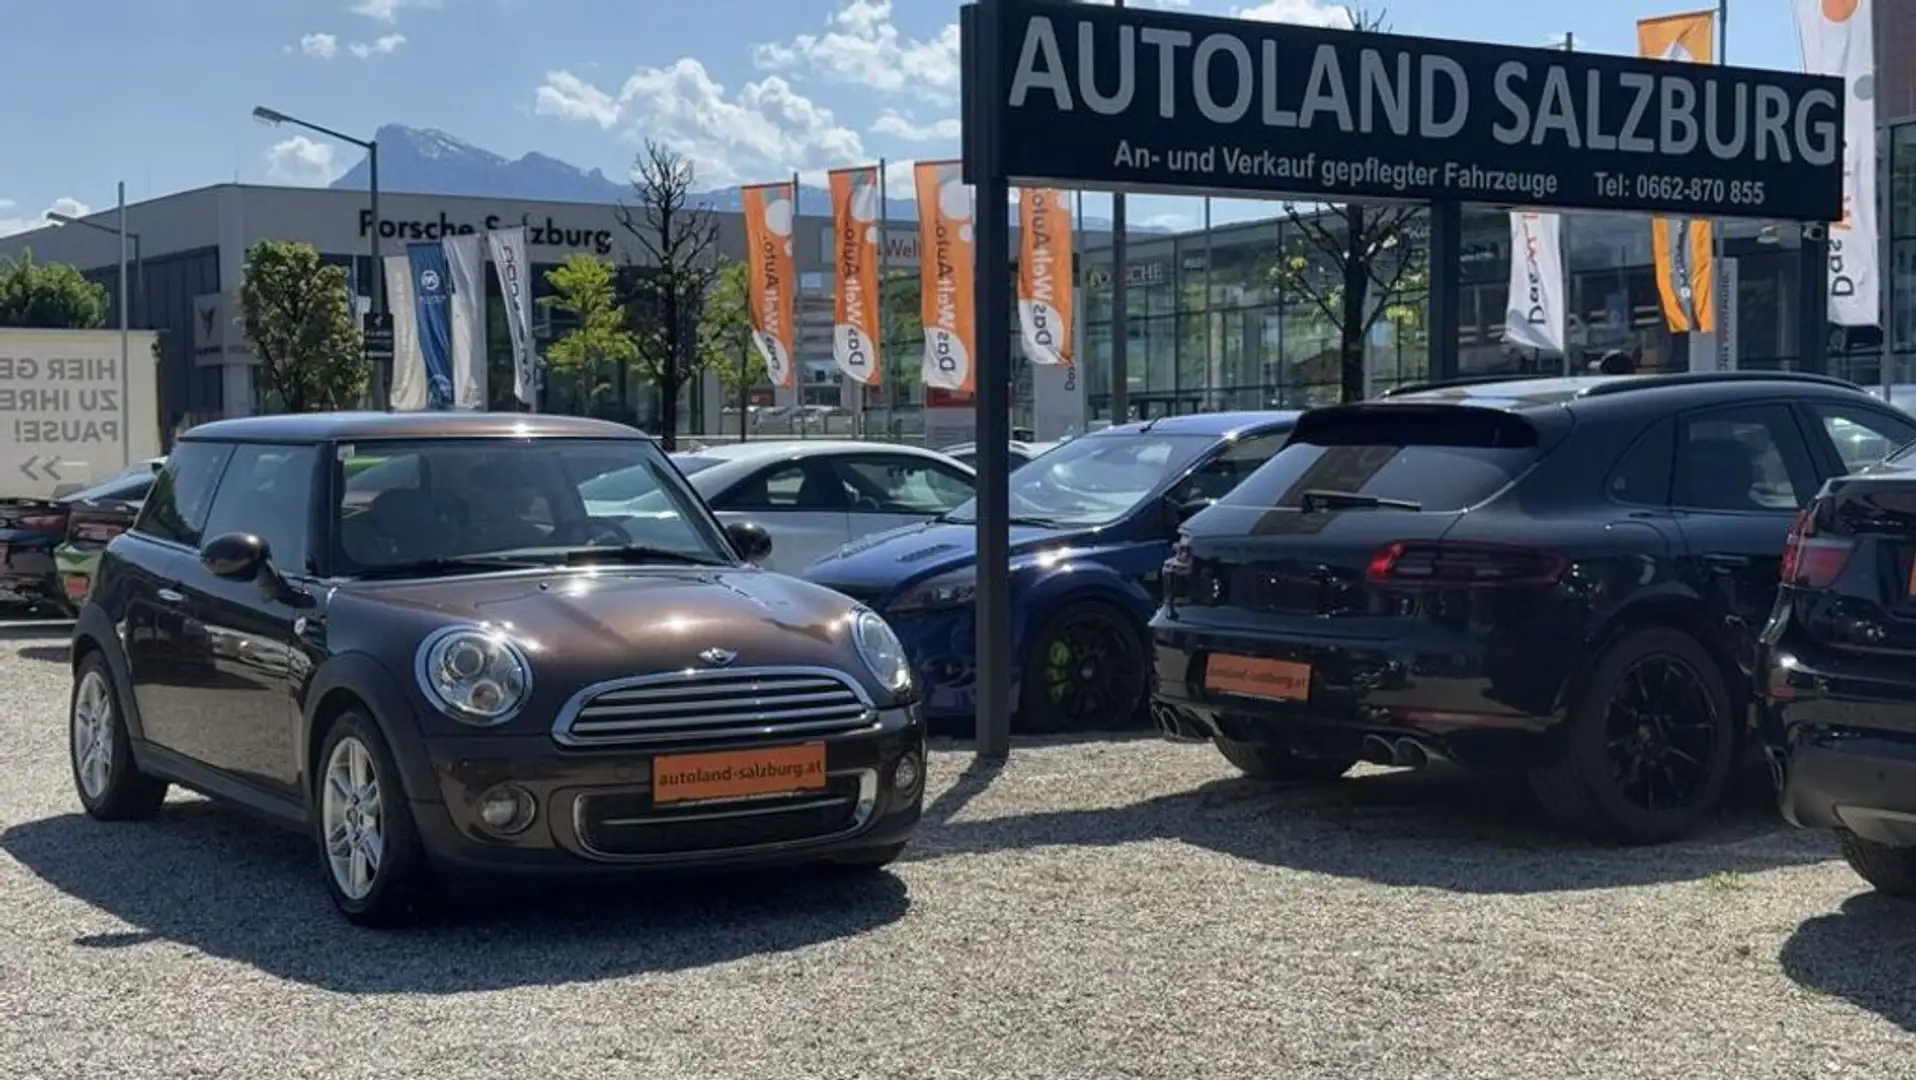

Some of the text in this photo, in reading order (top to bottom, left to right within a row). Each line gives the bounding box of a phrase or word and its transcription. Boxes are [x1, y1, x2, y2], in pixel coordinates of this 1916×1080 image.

[1008, 15, 1838, 165] AUTOLAND SALZBURG
[1113, 140, 1765, 205] An- und Verkauf gepflegter Fahrzeuge Tel: 0662-870 855
[658, 759, 823, 787] autoland-salzburg.at
